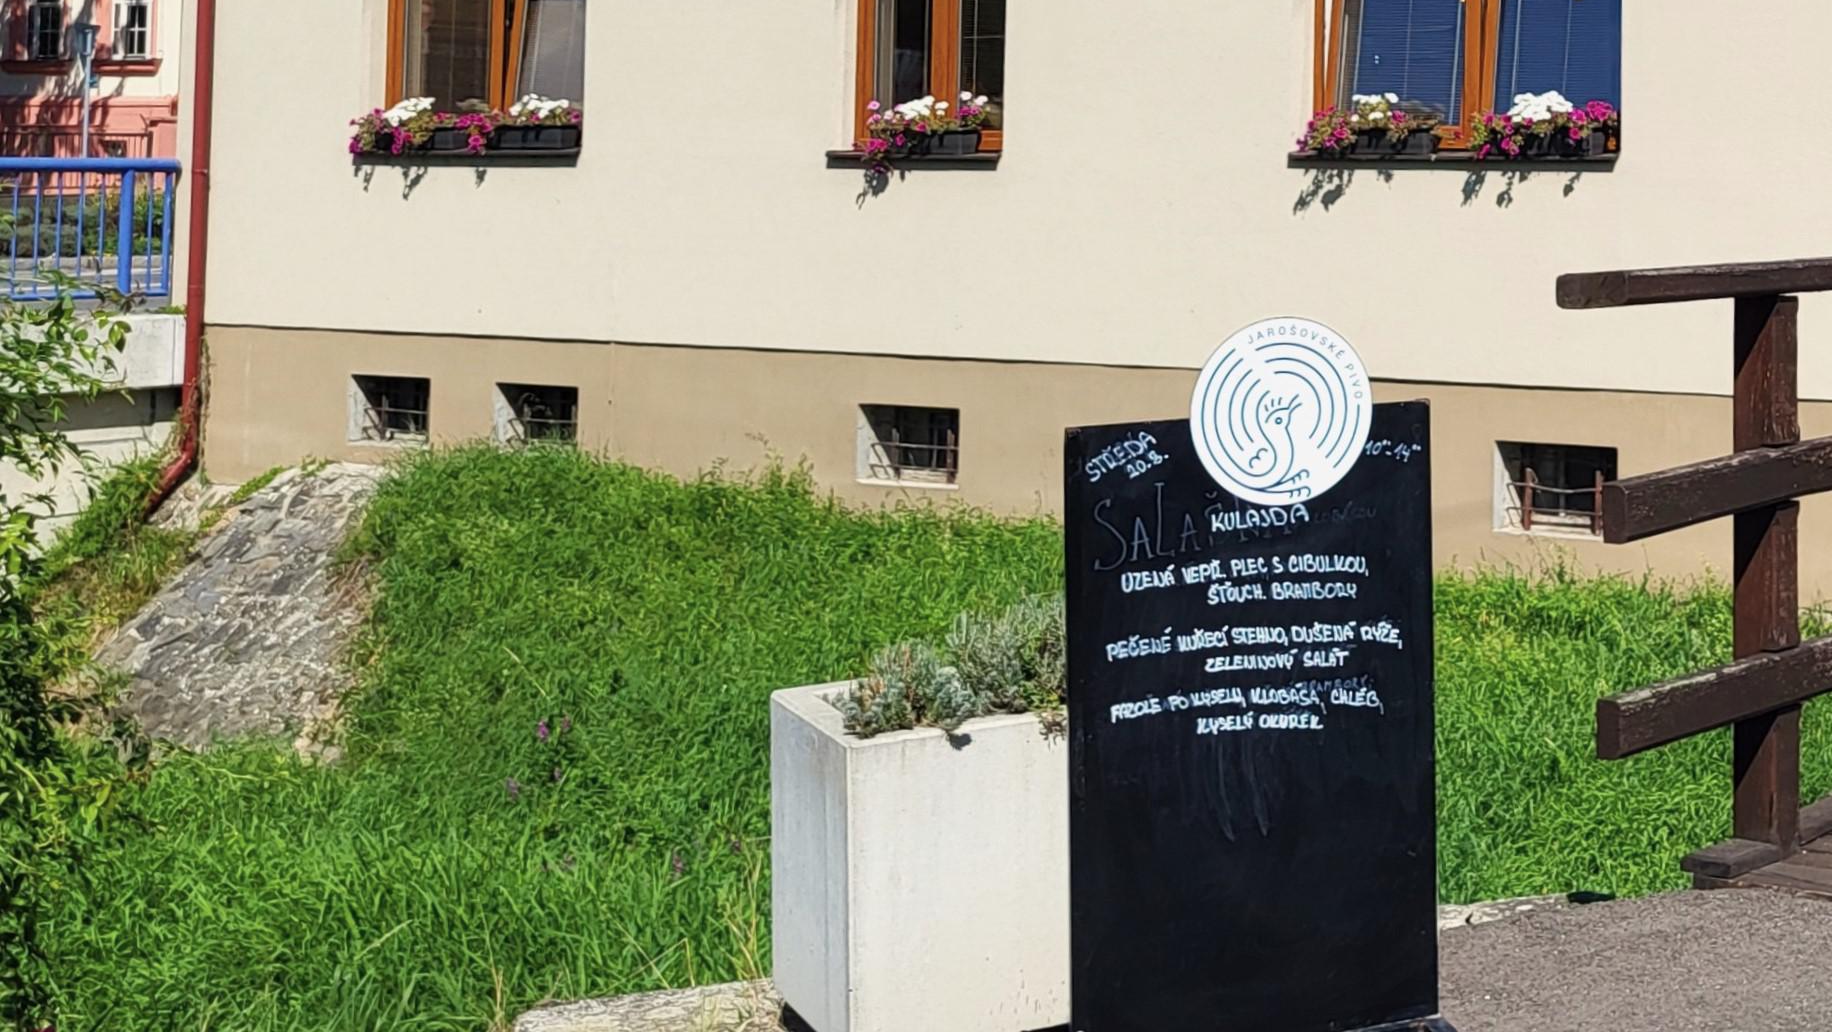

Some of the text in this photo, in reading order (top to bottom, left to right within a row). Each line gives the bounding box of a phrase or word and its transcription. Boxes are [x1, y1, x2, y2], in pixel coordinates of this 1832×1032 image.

[1248, 324, 1363, 399] JAROŠOVSKÉ PIVO
[1085, 431, 1157, 482] STŘEDA
[1210, 504, 1310, 532] KULAJDA
[1120, 564, 1176, 593] UZENÁ
[1230, 556, 1268, 577] PLEC
[1271, 555, 1284, 574] S
[1271, 581, 1357, 600] BRAMBORY
[1106, 626, 1172, 662] PEČENÉ
[1177, 625, 1229, 652] KUŘECÍ
[1290, 621, 1357, 643] DUŠENÁ
[1303, 647, 1350, 667] SALÁT
[1196, 711, 1254, 735] KYSELÝ
